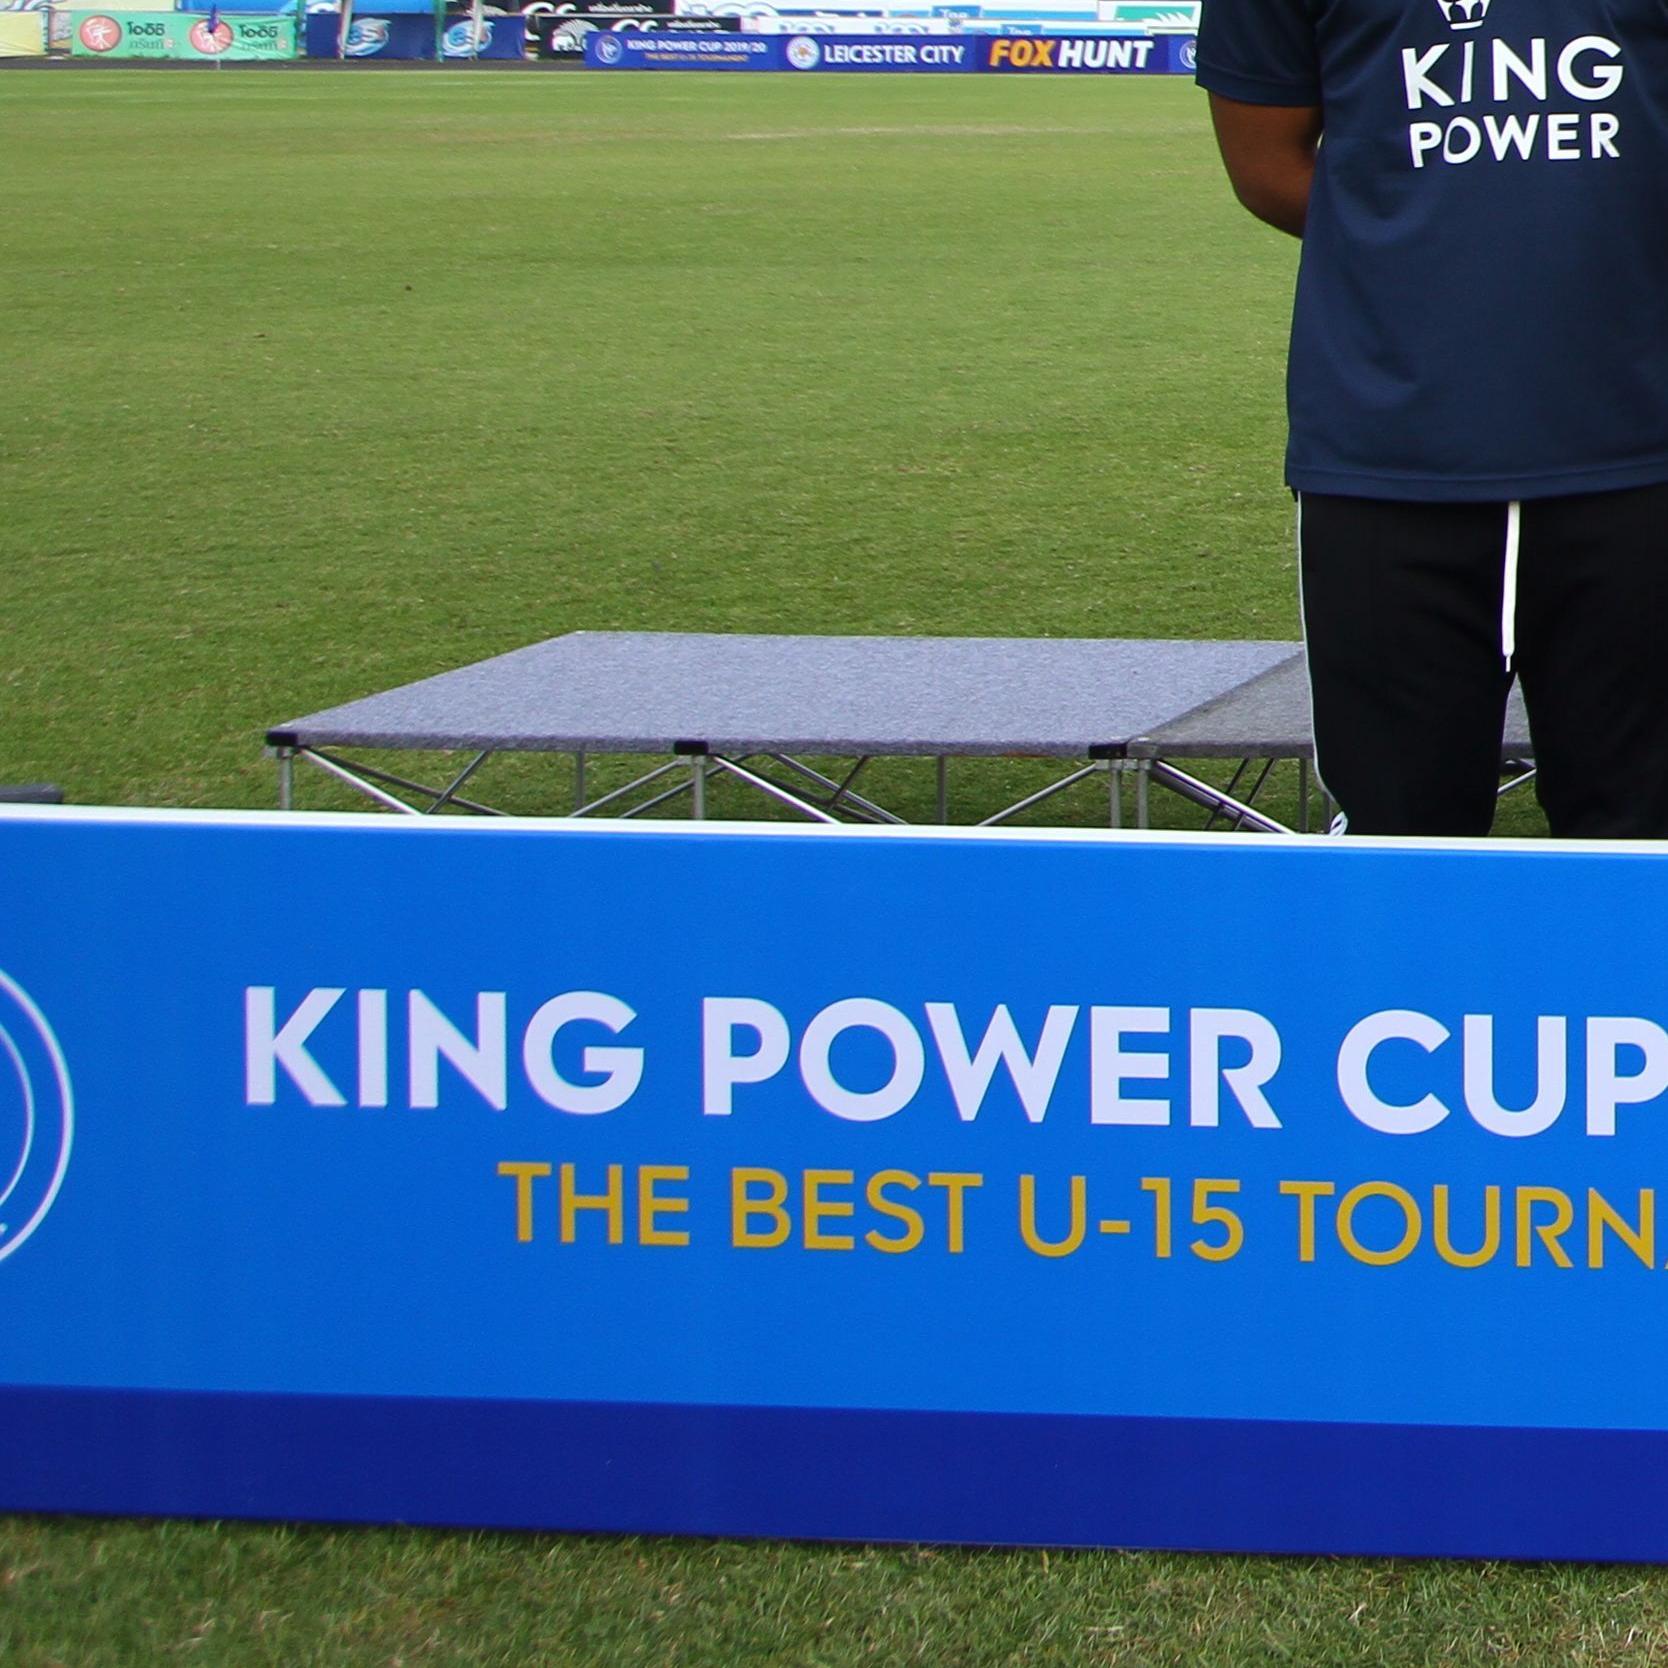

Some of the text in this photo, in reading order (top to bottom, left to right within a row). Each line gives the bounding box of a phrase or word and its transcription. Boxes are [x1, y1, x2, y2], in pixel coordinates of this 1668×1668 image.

[824, 44, 965, 65] LEICESTER CITY
[988, 39, 1154, 69] FOX HUNT
[1401, 35, 1624, 110] KING
[1408, 112, 1621, 169] POWER
[246, 987, 643, 1115] KING
[703, 997, 1283, 1128] POWER
[498, 1162, 690, 1246] THE
[732, 1168, 983, 1254] BEST
[1020, 1175, 1243, 1261] U-15
